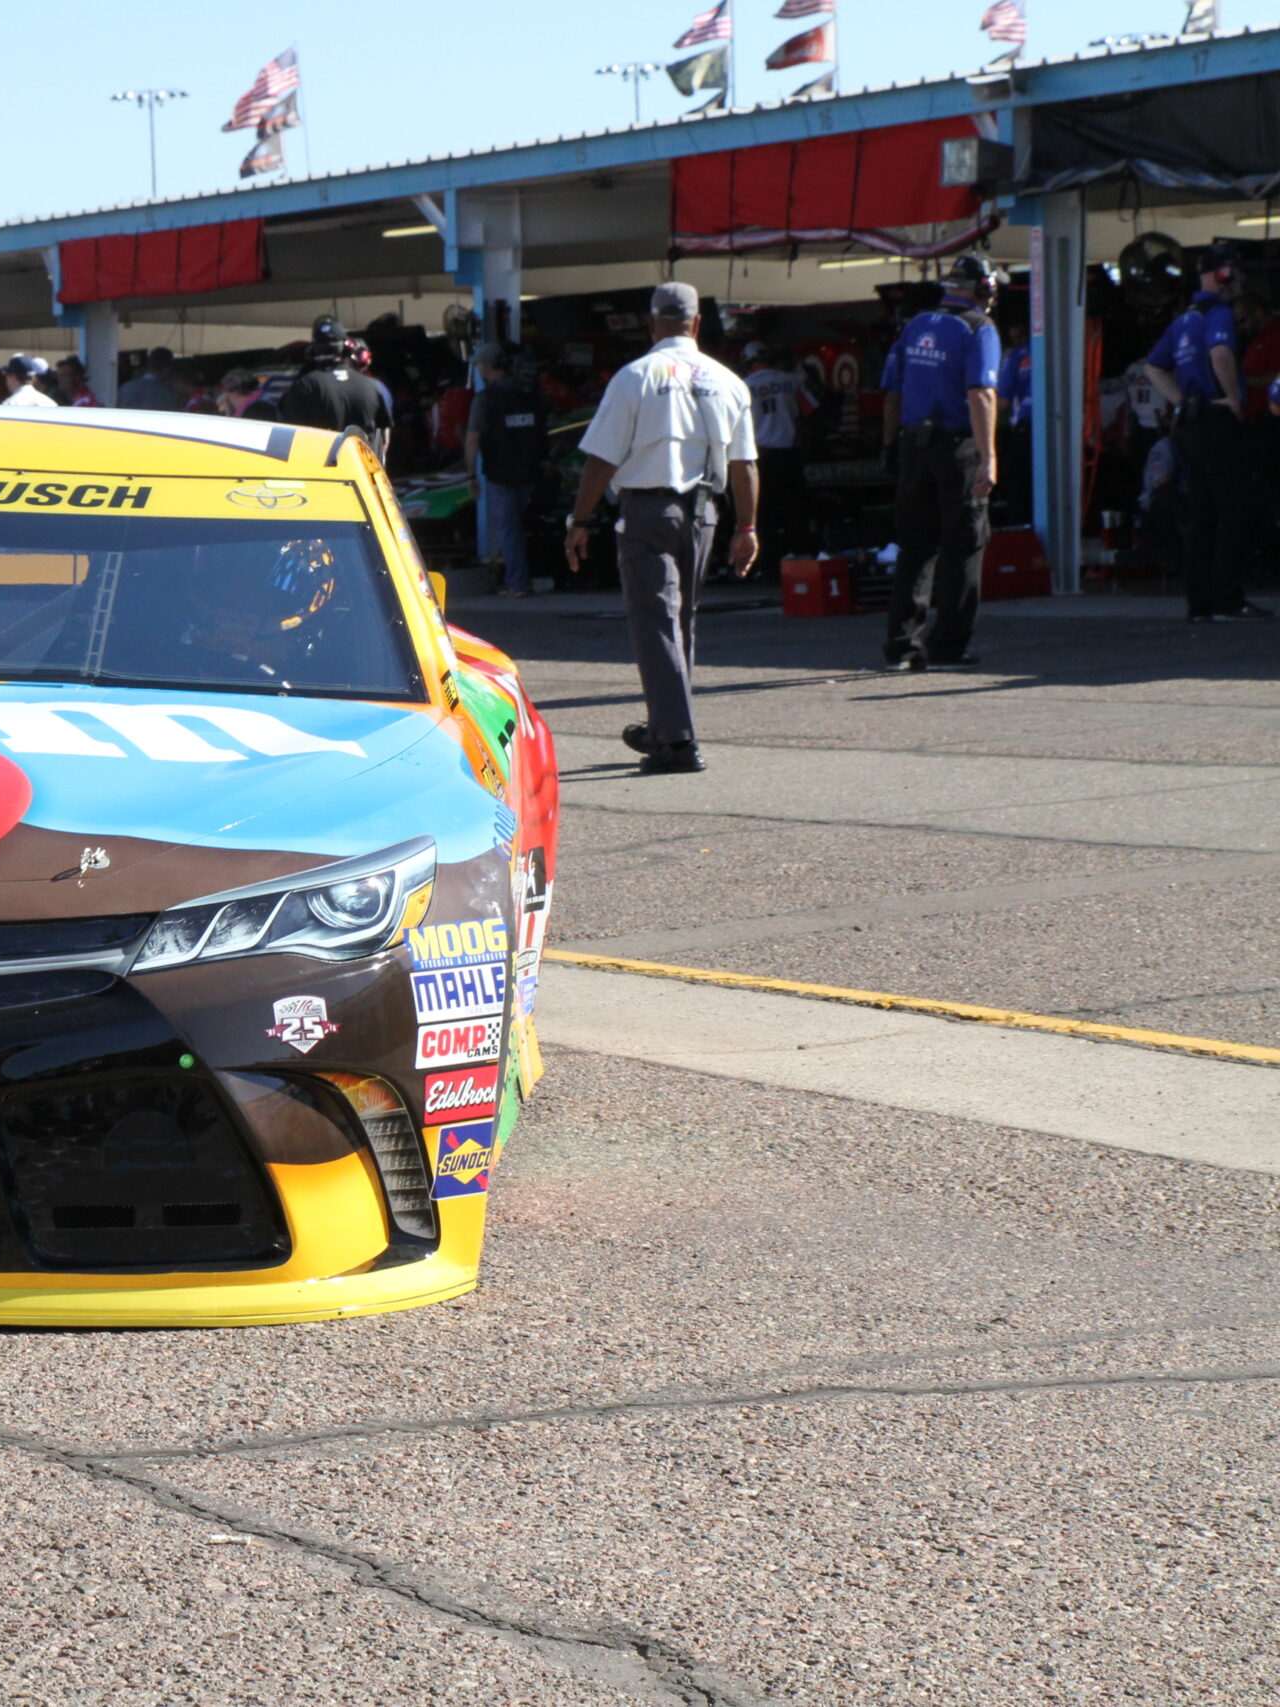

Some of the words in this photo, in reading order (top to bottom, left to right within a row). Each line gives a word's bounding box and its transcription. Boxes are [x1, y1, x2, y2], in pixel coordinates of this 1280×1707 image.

[408, 917, 508, 961] MOOG
[412, 966, 505, 1013] MAHLE
[281, 1016, 326, 1042] 25
[421, 1024, 487, 1059] COMP
[466, 1045, 499, 1058] CAMS
